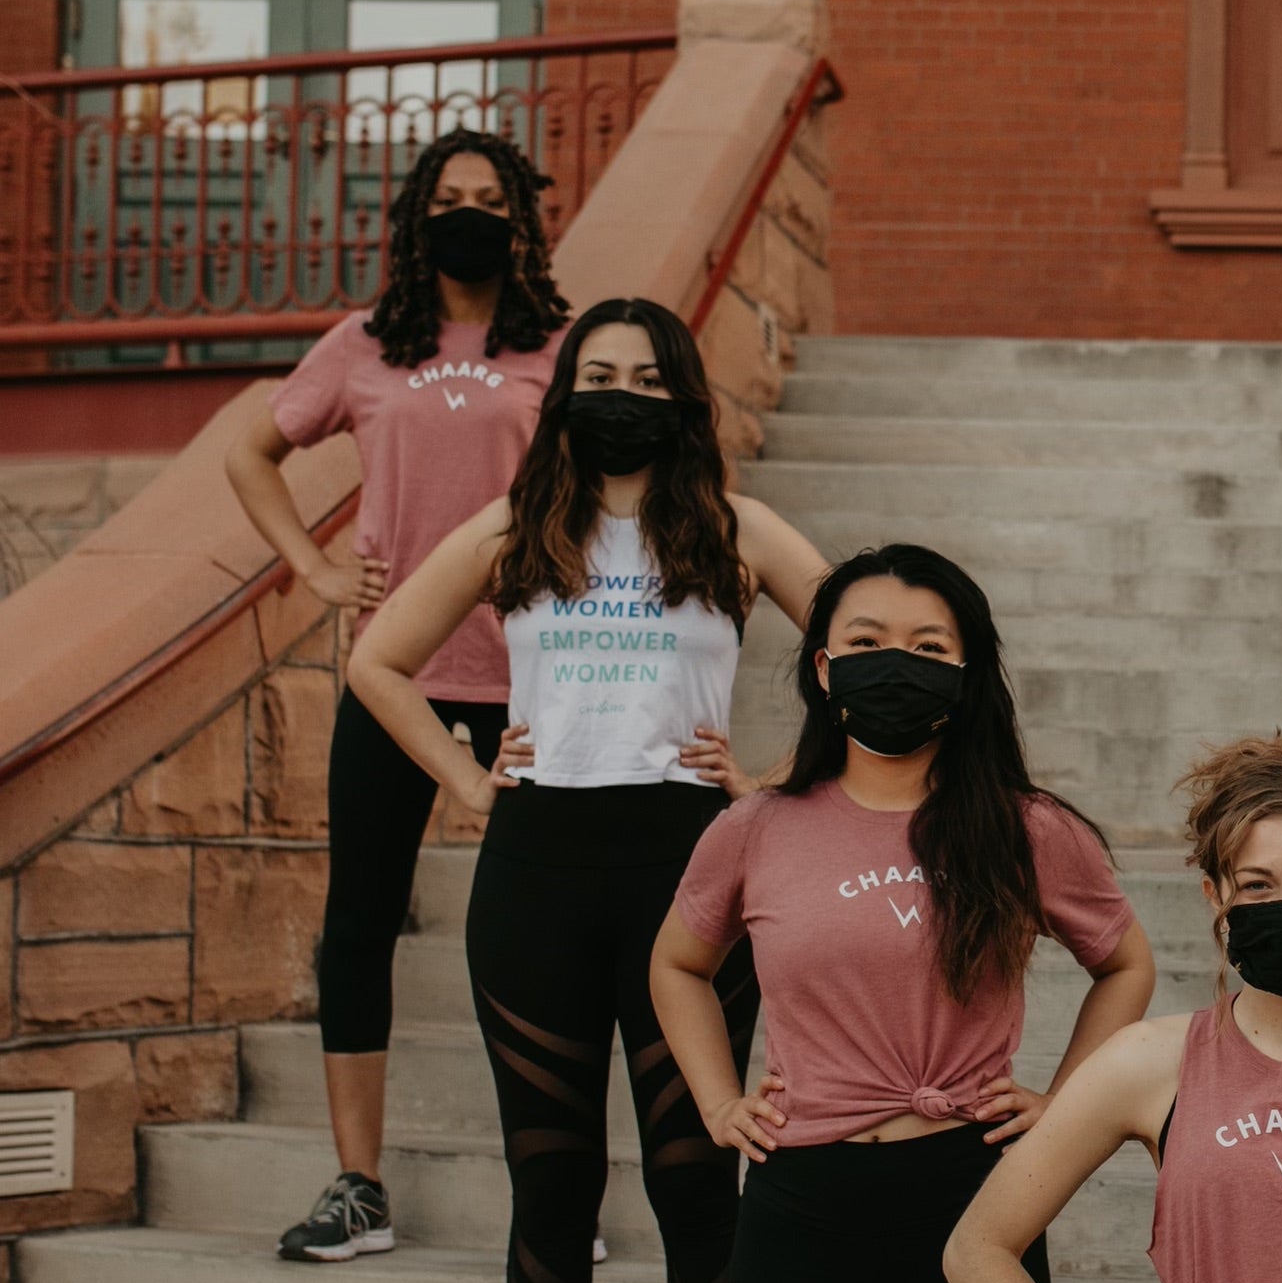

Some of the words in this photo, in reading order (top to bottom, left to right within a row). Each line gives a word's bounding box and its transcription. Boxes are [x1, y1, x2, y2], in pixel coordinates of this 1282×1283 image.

[407, 360, 504, 389] CHAARG
[553, 600, 664, 618] WOMEN
[539, 630, 677, 651] EMPOWER
[553, 664, 659, 683] WOMEN
[838, 866, 947, 898] CHAA
